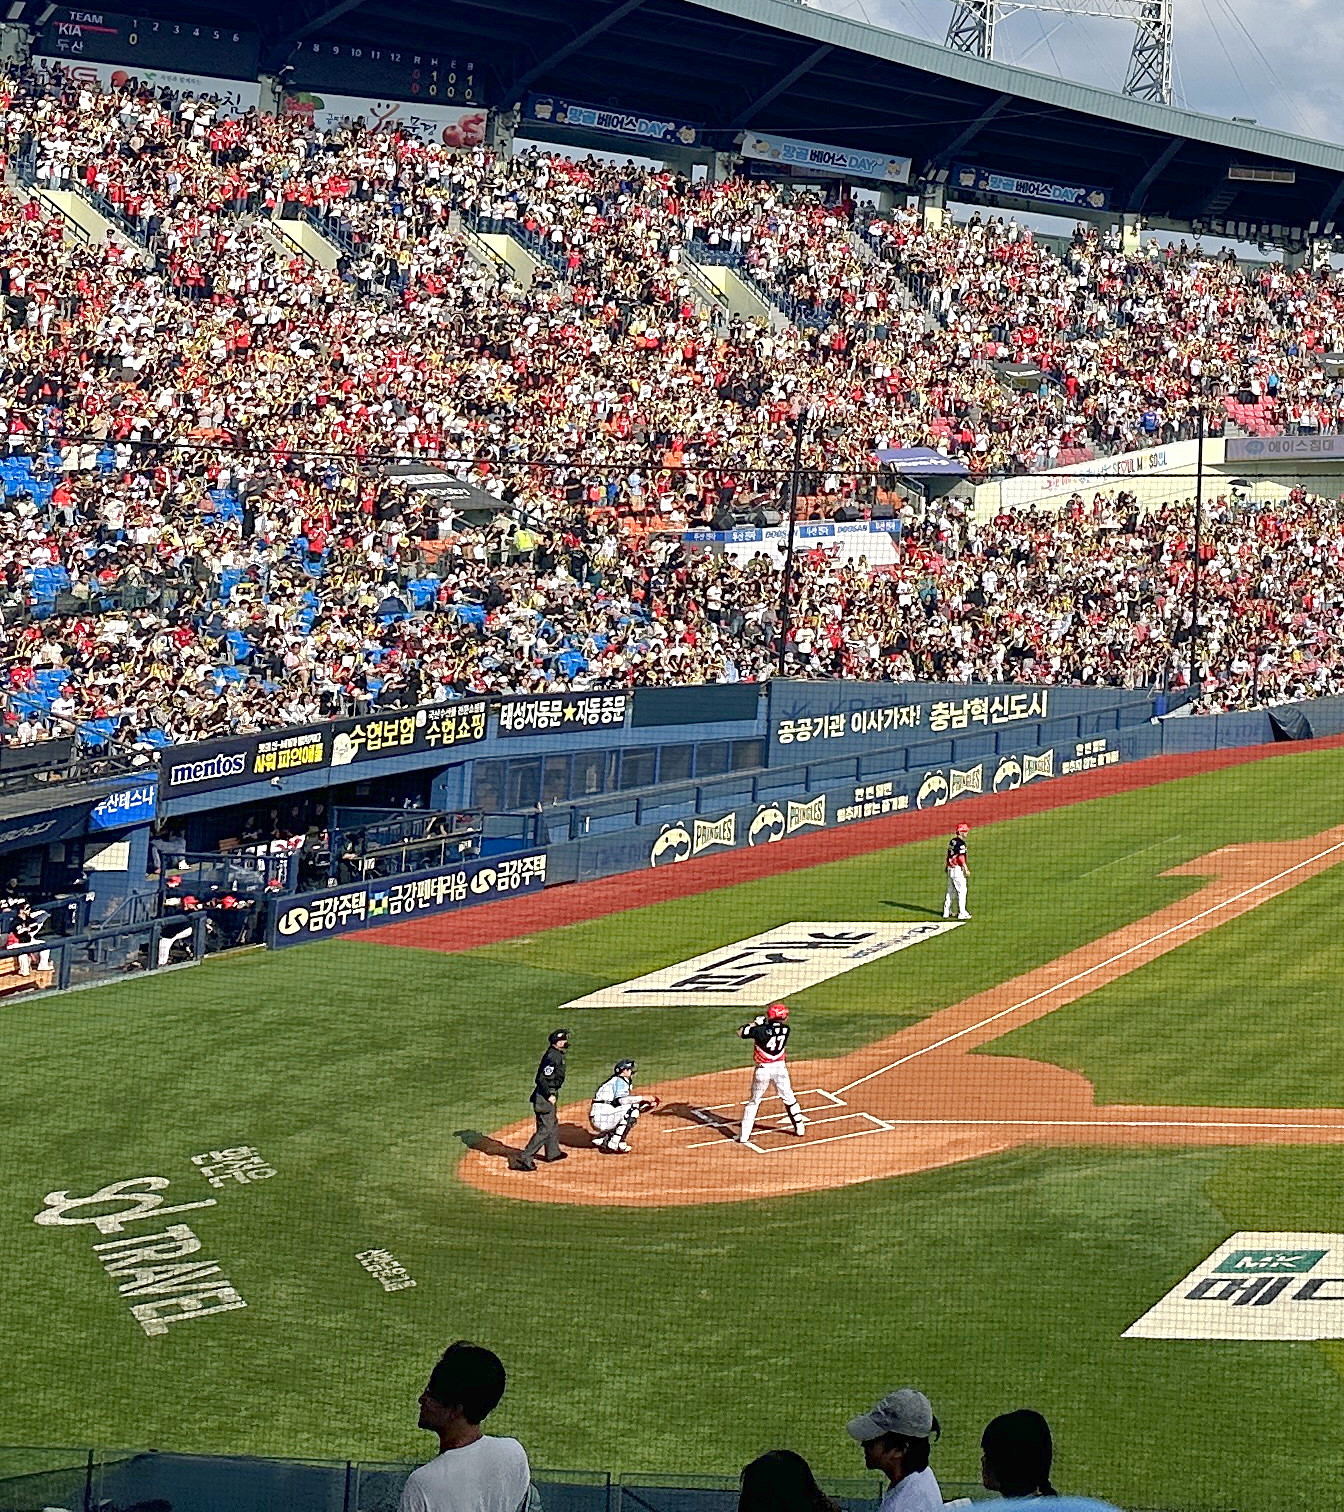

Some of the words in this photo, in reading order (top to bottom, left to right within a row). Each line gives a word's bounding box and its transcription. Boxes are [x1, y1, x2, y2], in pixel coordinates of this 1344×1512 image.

[59, 23, 82, 36] KIA
[129, 34, 137, 45] 0
[70, 11, 103, 24] TEAM
[152, 22, 159, 32] 2
[173, 25, 180, 34] 3
[193, 28, 200, 36] 4
[213, 31, 219, 39] 5
[233, 33, 239, 42] 6
[56, 39, 83, 53] 두산
[352, 48, 361, 57] 10
[391, 54, 400, 62] 12
[1268, 439, 1334, 453] 에이스침대
[500, 700, 562, 730] 태성자동문
[575, 695, 626, 725] 자동중문
[777, 714, 847, 744] 공공기관
[851, 704, 921, 734] 이사가자!
[929, 690, 1048, 732] 충남혁신도시
[350, 716, 415, 751] 수협보험
[425, 713, 486, 747] 수협쇼핑
[170, 752, 247, 785] mentos
[790, 800, 825, 829] PRINGLES
[695, 816, 735, 847] PRINGLES
[496, 854, 547, 891] 금강주택
[308, 890, 367, 932] 금강주택
[388, 870, 468, 915] 금강펜테리움
[766, 1035, 785, 1051] 47
[1232, 1253, 1304, 1269] MK
[92, 1223, 249, 1337] TRAVEL
